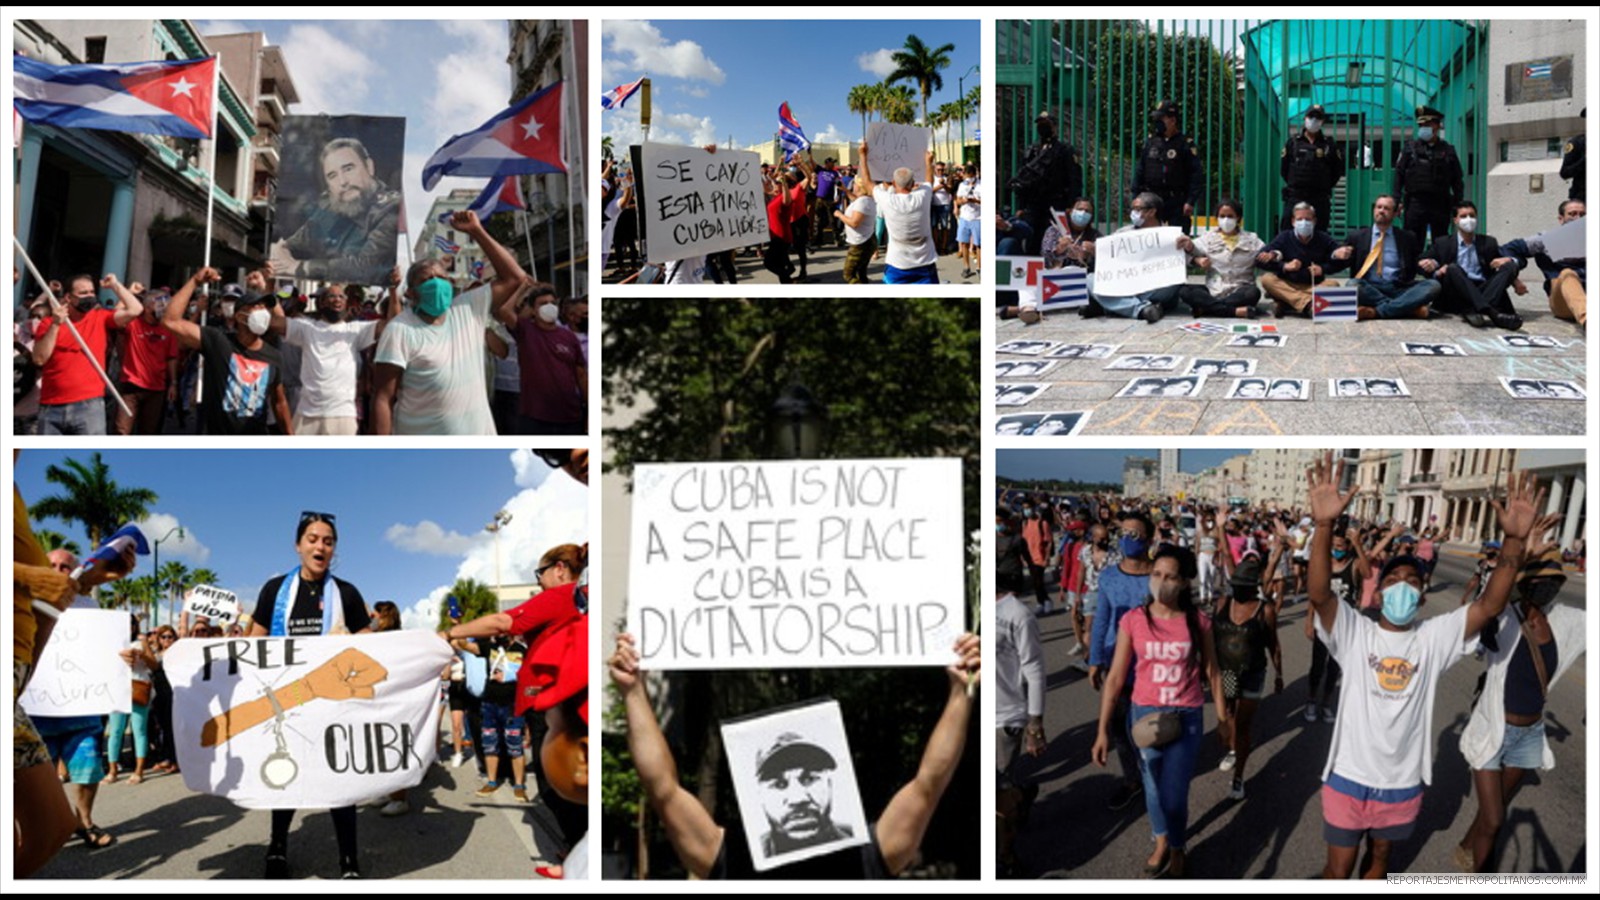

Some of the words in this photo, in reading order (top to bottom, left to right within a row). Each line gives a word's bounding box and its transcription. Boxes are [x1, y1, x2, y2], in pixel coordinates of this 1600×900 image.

[656, 160, 694, 182] SE
[705, 162, 750, 185] CAYÓ
[658, 191, 704, 221] ESTA
[673, 218, 725, 245] CUBA
[728, 215, 767, 238] LIBRE
[1096, 269, 1113, 282] NO
[671, 465, 773, 512] CUBA
[791, 466, 827, 506] IS
[834, 465, 907, 509] NOT
[646, 521, 669, 564] A
[683, 519, 801, 563] SAFE
[817, 516, 928, 561] PLACE
[693, 566, 793, 601] CUBA
[802, 567, 831, 598] IS
[845, 567, 868, 599] A
[641, 602, 948, 659] DICTATORSHIP
[202, 638, 308, 681] FREE
[1144, 641, 1192, 660] JUST
[1152, 663, 1182, 683] DO
[324, 722, 424, 774] CUBA
